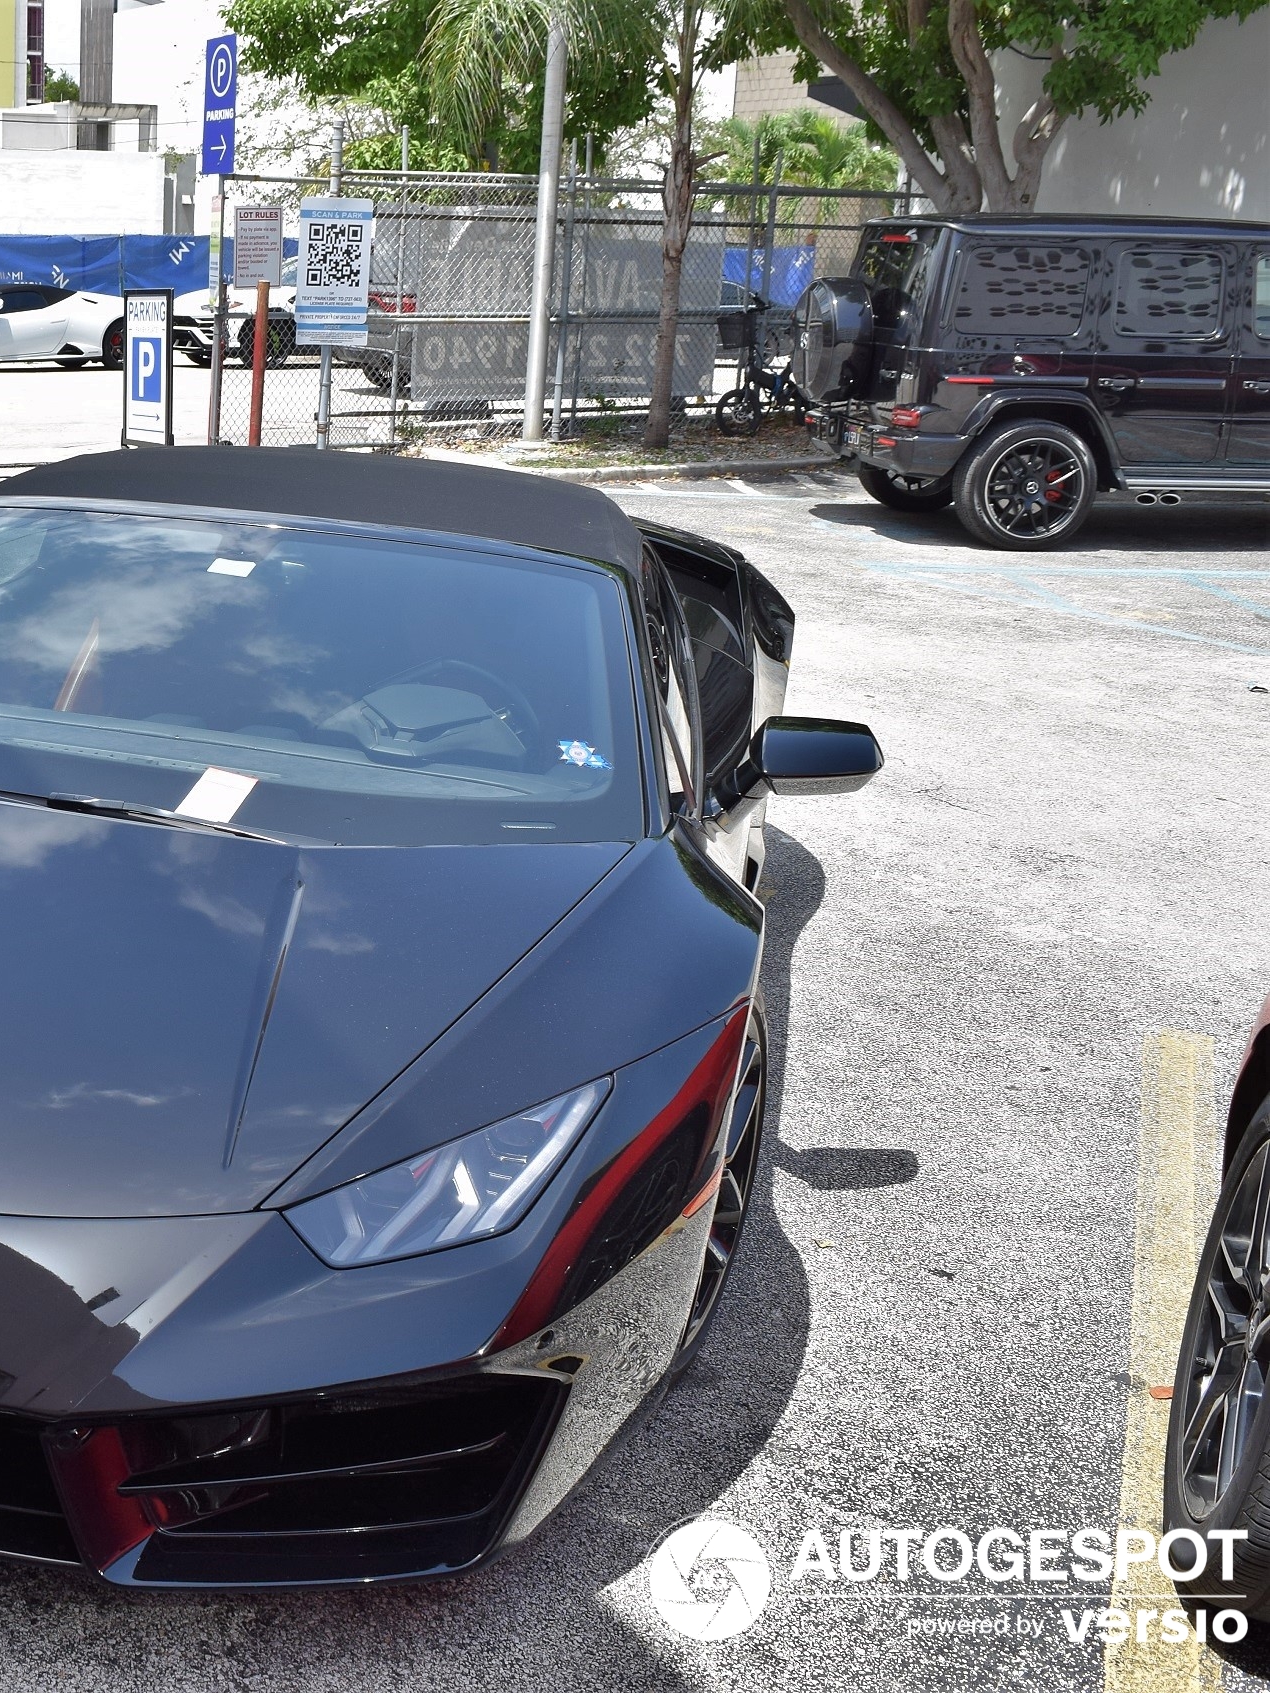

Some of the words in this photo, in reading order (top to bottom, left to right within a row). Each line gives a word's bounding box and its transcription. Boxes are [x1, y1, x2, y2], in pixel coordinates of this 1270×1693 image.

[206, 108, 234, 121] PARKING
[129, 302, 166, 322] PARKING
[138, 341, 155, 398] P
